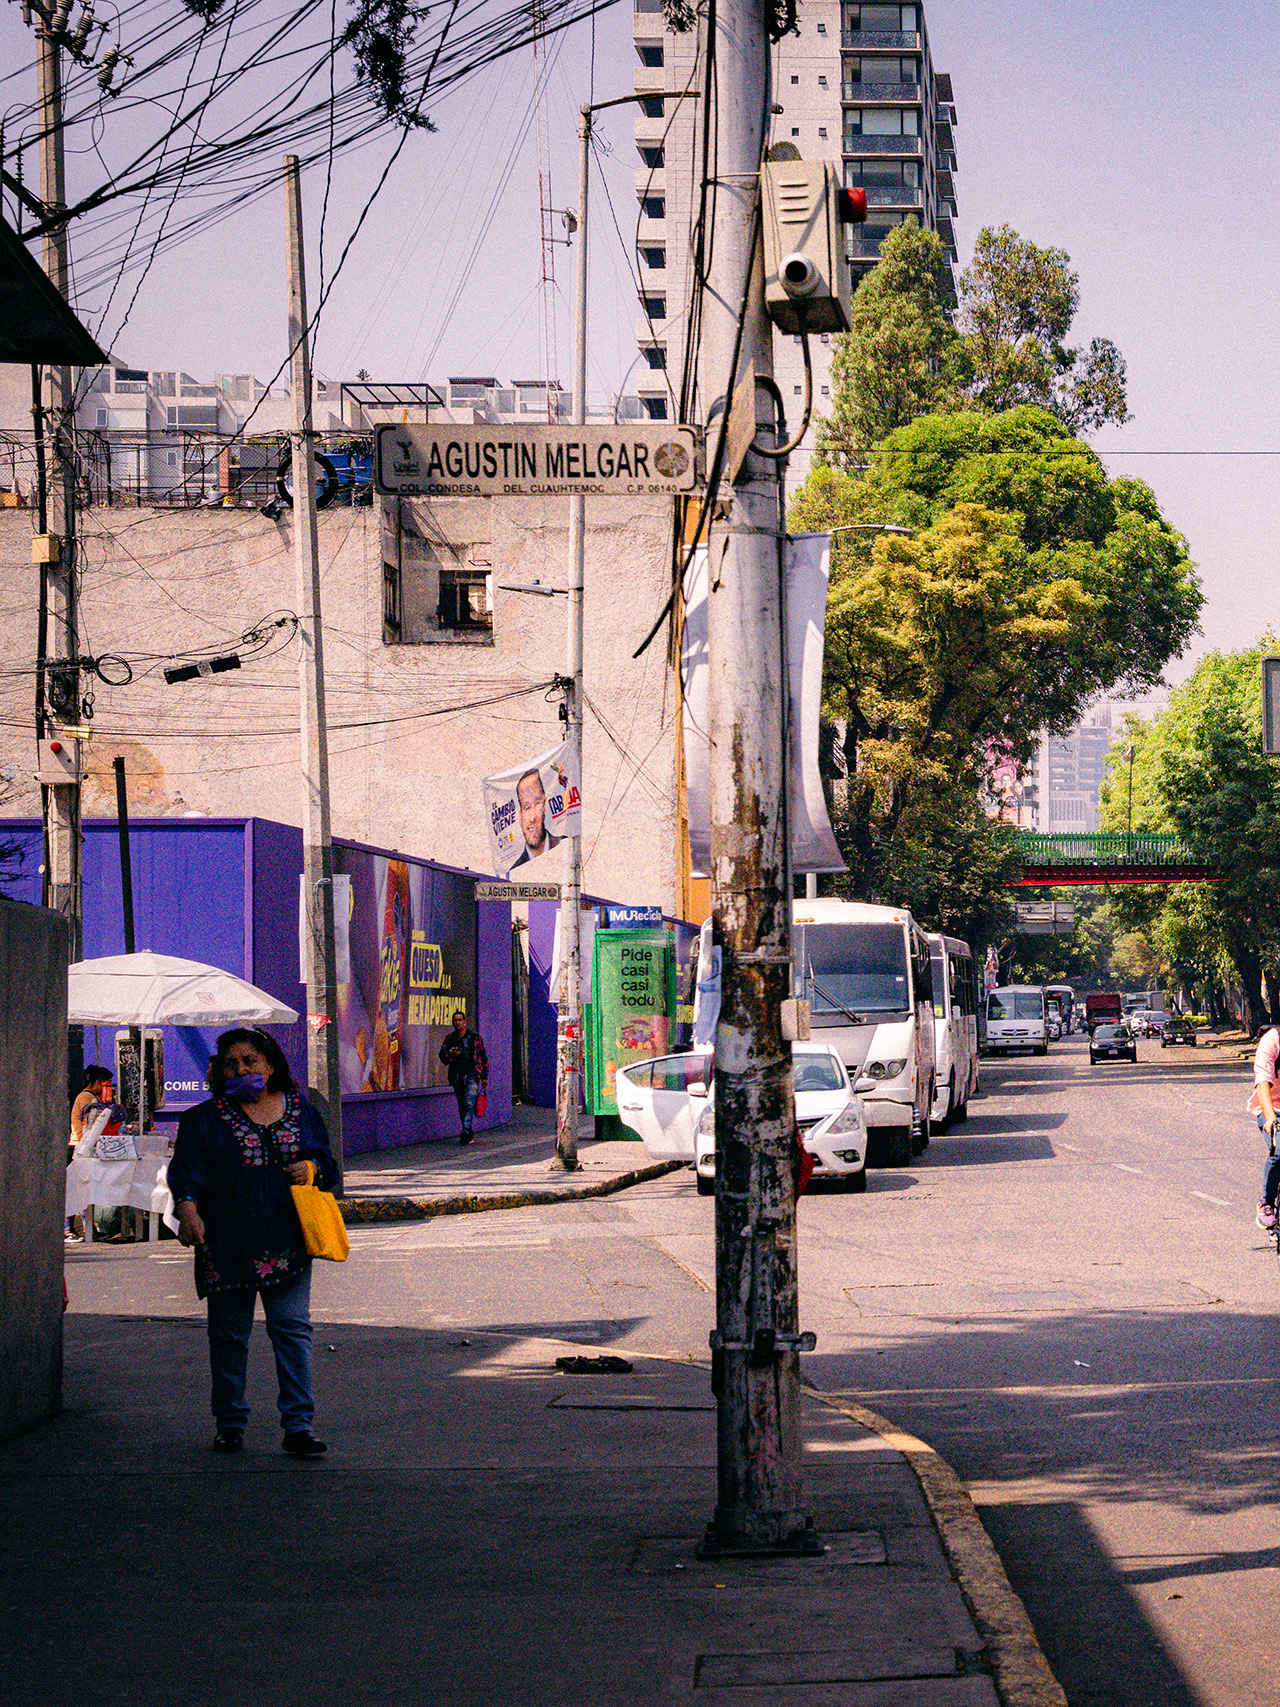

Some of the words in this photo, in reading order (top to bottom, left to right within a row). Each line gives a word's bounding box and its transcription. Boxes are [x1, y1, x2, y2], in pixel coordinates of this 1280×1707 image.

[426, 441, 537, 478] AGUSTIN
[545, 442, 651, 478] MELGAR
[428, 483, 481, 493] CONDESA
[530, 484, 605, 493] CUAUHTEMOC
[649, 484, 677, 493] 06140
[491, 799, 516, 826] CAMBIO
[492, 811, 516, 836] VIENE
[487, 886, 518, 897] AGUSTIN
[519, 886, 548, 897] MELGAR
[621, 948, 653, 961] Pide
[412, 946, 440, 984] QUESO
[621, 963, 649, 976] casi
[621, 978, 649, 991] casi
[621, 994, 655, 1007] todo
[163, 1081, 200, 1091] COME
